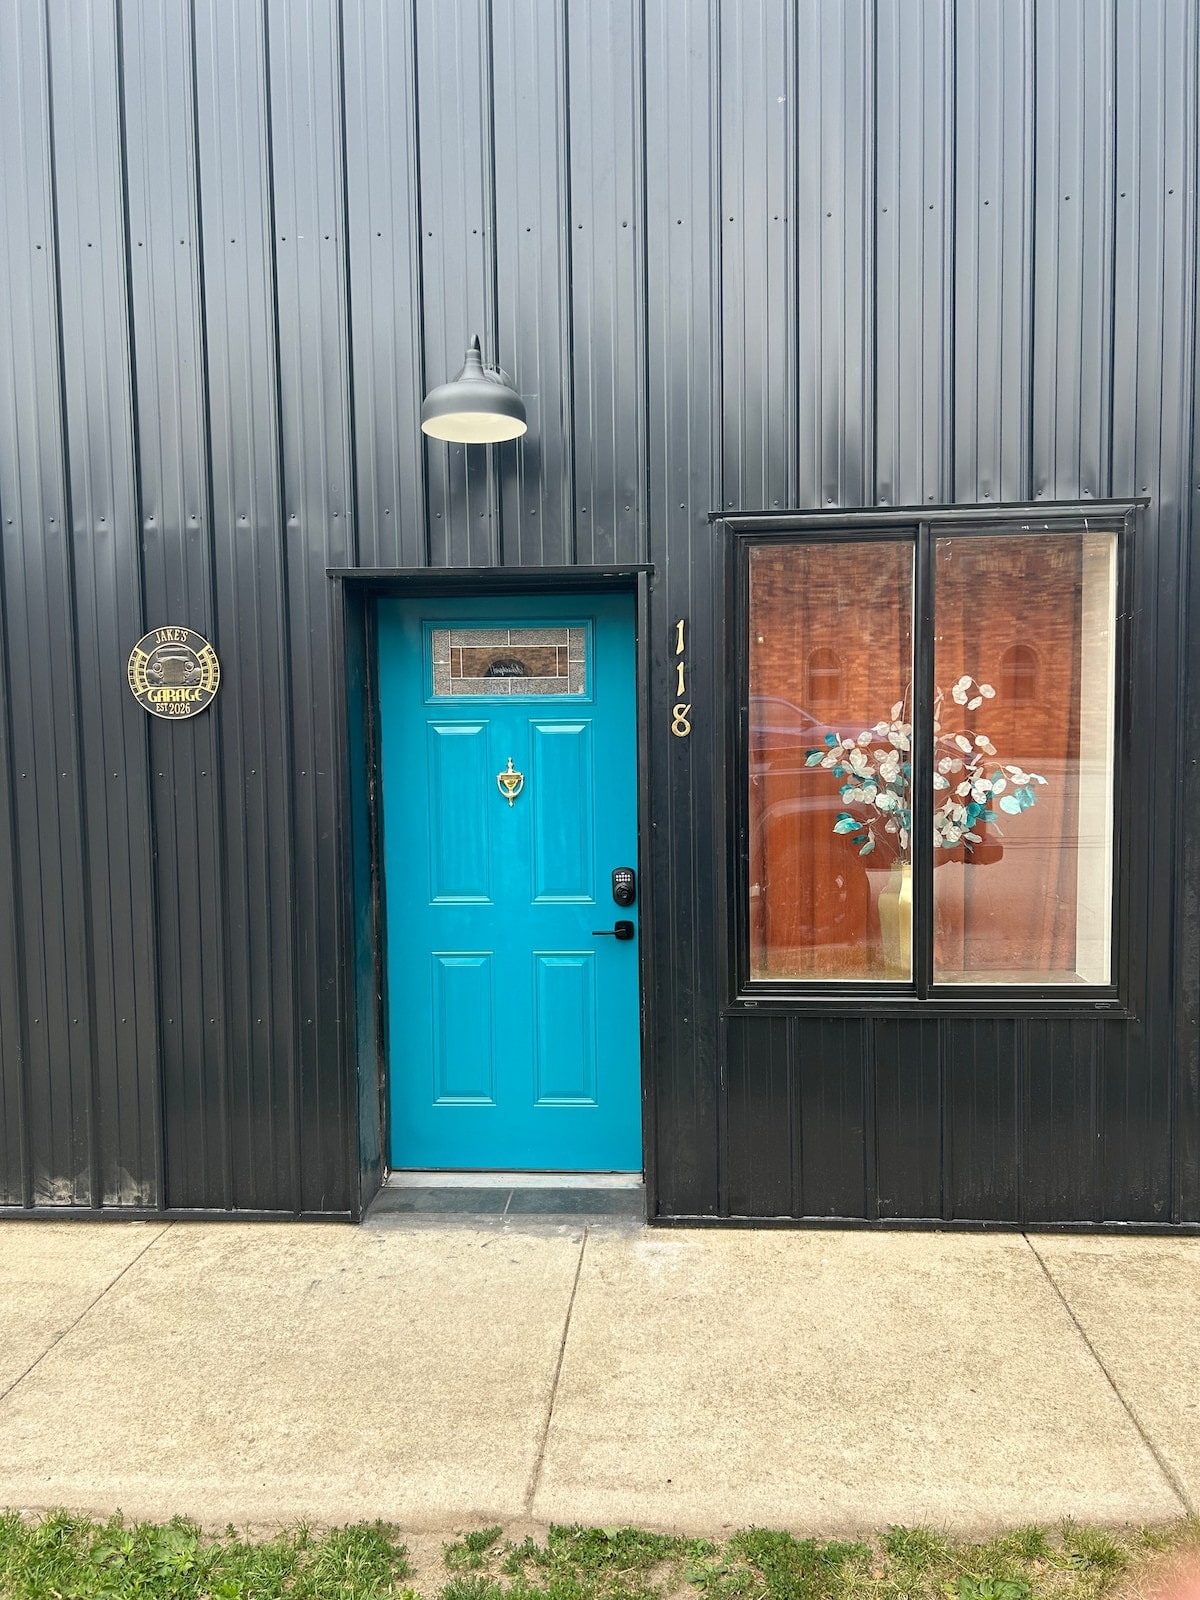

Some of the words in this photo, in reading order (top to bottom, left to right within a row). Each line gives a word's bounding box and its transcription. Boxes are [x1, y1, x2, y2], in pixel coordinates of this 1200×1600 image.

[155, 629, 188, 643] JAKE'S
[147, 688, 203, 702] GARAGE
[156, 703, 168, 712] EST
[169, 703, 191, 714] 2026
